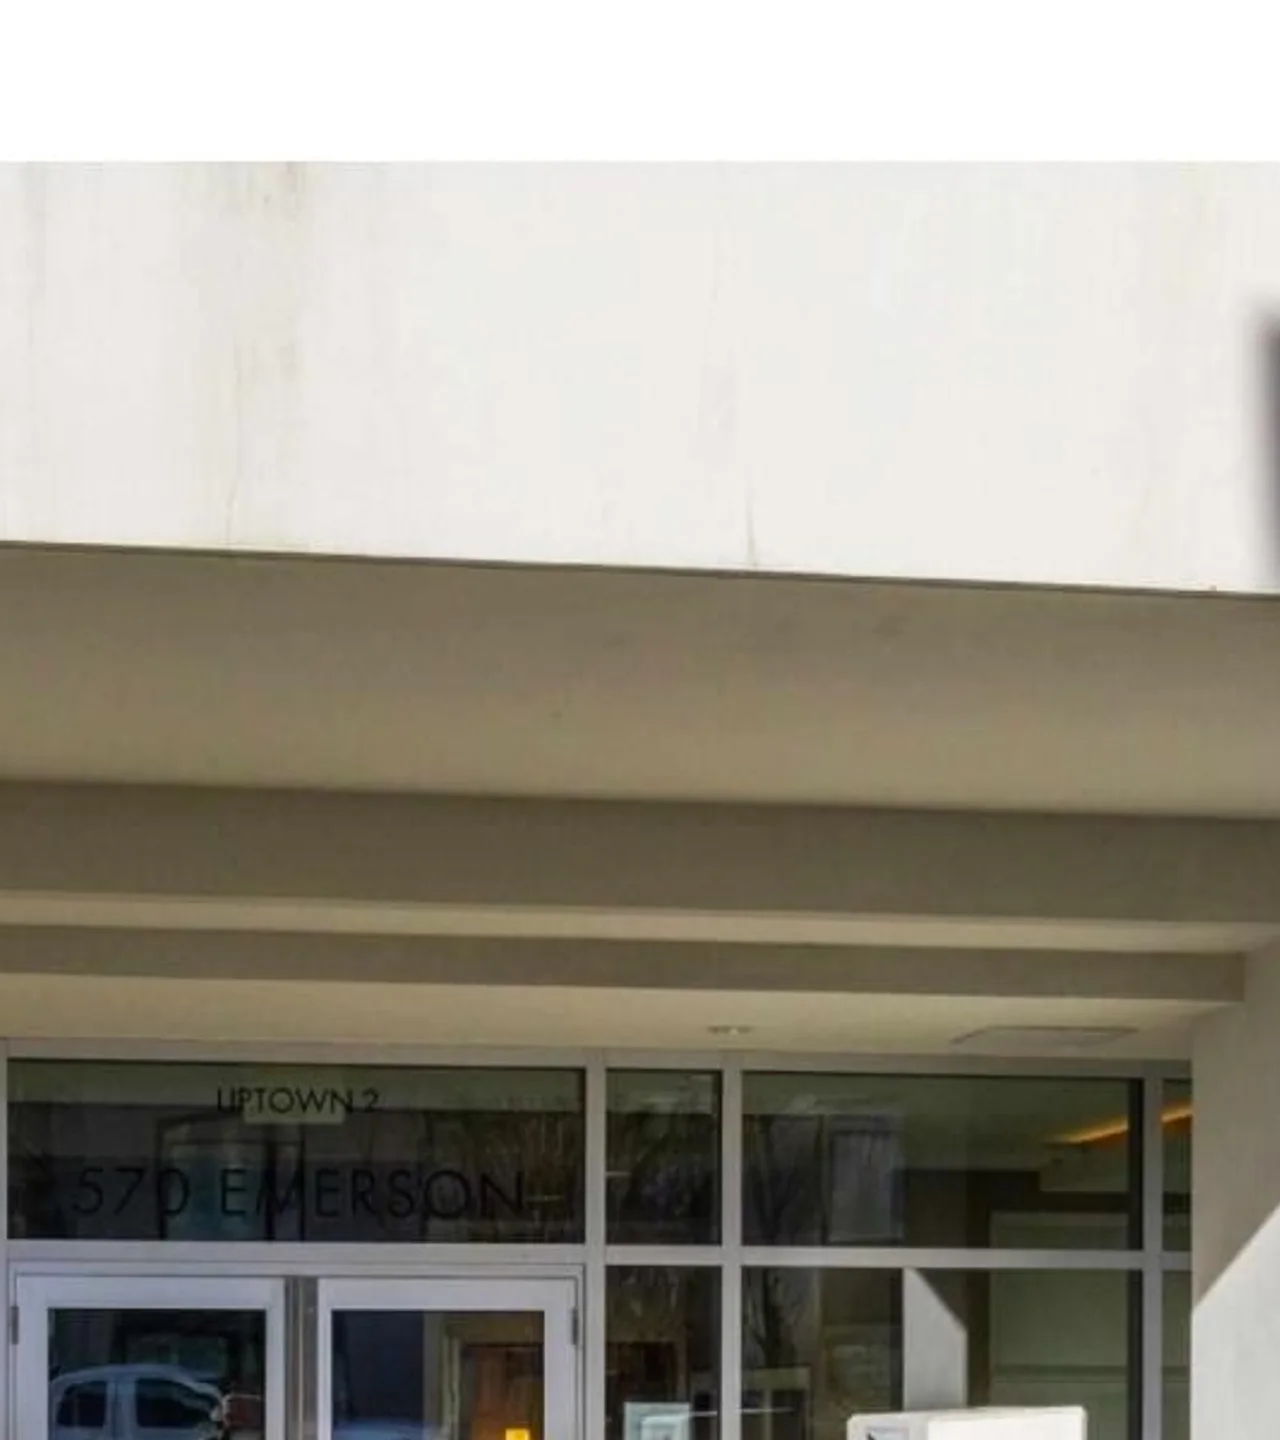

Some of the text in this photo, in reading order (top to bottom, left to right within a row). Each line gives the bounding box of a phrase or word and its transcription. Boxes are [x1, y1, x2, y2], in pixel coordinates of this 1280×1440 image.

[216, 1086, 381, 1117] UPTOWN 2
[73, 1165, 526, 1220] 570 EMERSON
